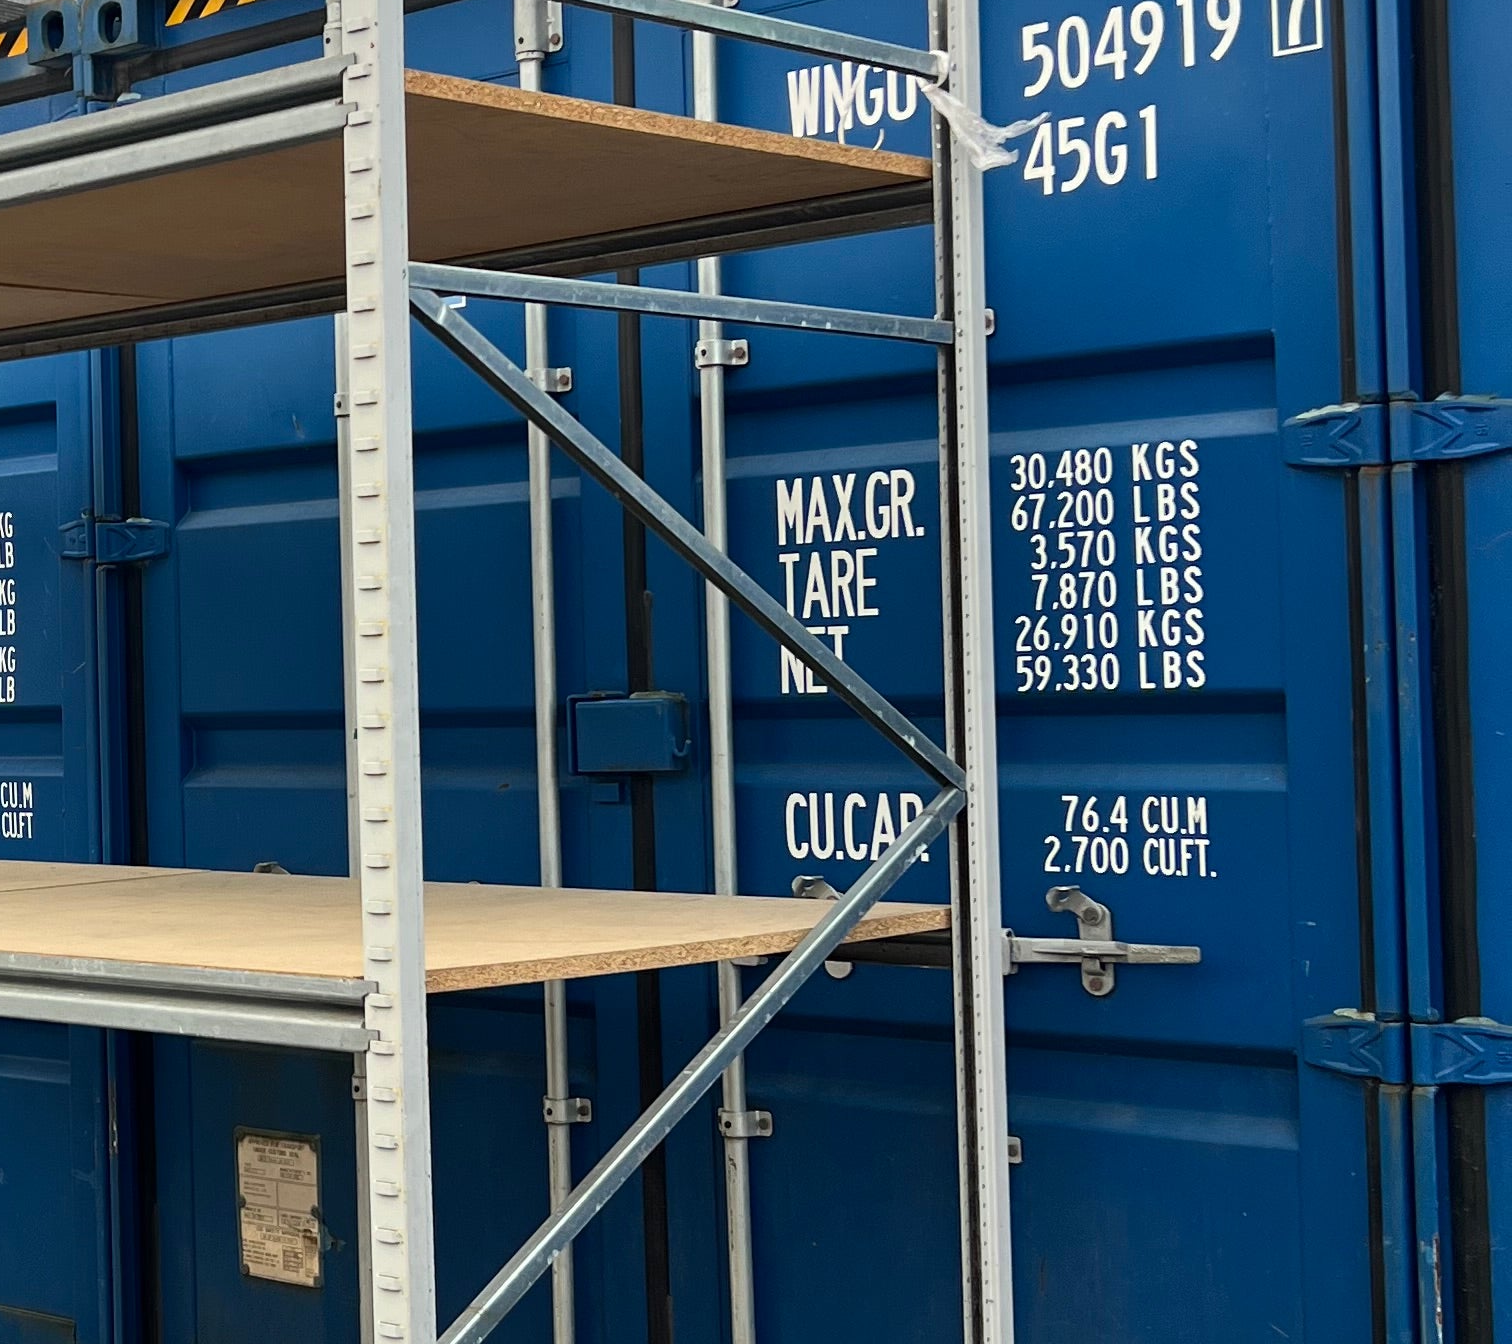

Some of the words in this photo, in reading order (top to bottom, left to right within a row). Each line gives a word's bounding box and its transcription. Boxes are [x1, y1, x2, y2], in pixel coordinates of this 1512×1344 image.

[1024, 104, 1158, 196] 45G1
[1130, 440, 1199, 482] KGS
[776, 468, 925, 546] MAX.GR.
[1132, 481, 1200, 524] LBS
[1134, 524, 1203, 565] KGS
[779, 548, 879, 620] TARE
[1136, 566, 1204, 606] LBS
[1137, 608, 1205, 648] KGS
[1138, 651, 1207, 691] LBS
[0, 781, 33, 808] CU.M
[1061, 795, 1128, 833] 76.4
[1141, 796, 1208, 835] CU.M
[1143, 837, 1217, 878] CU.FT.
